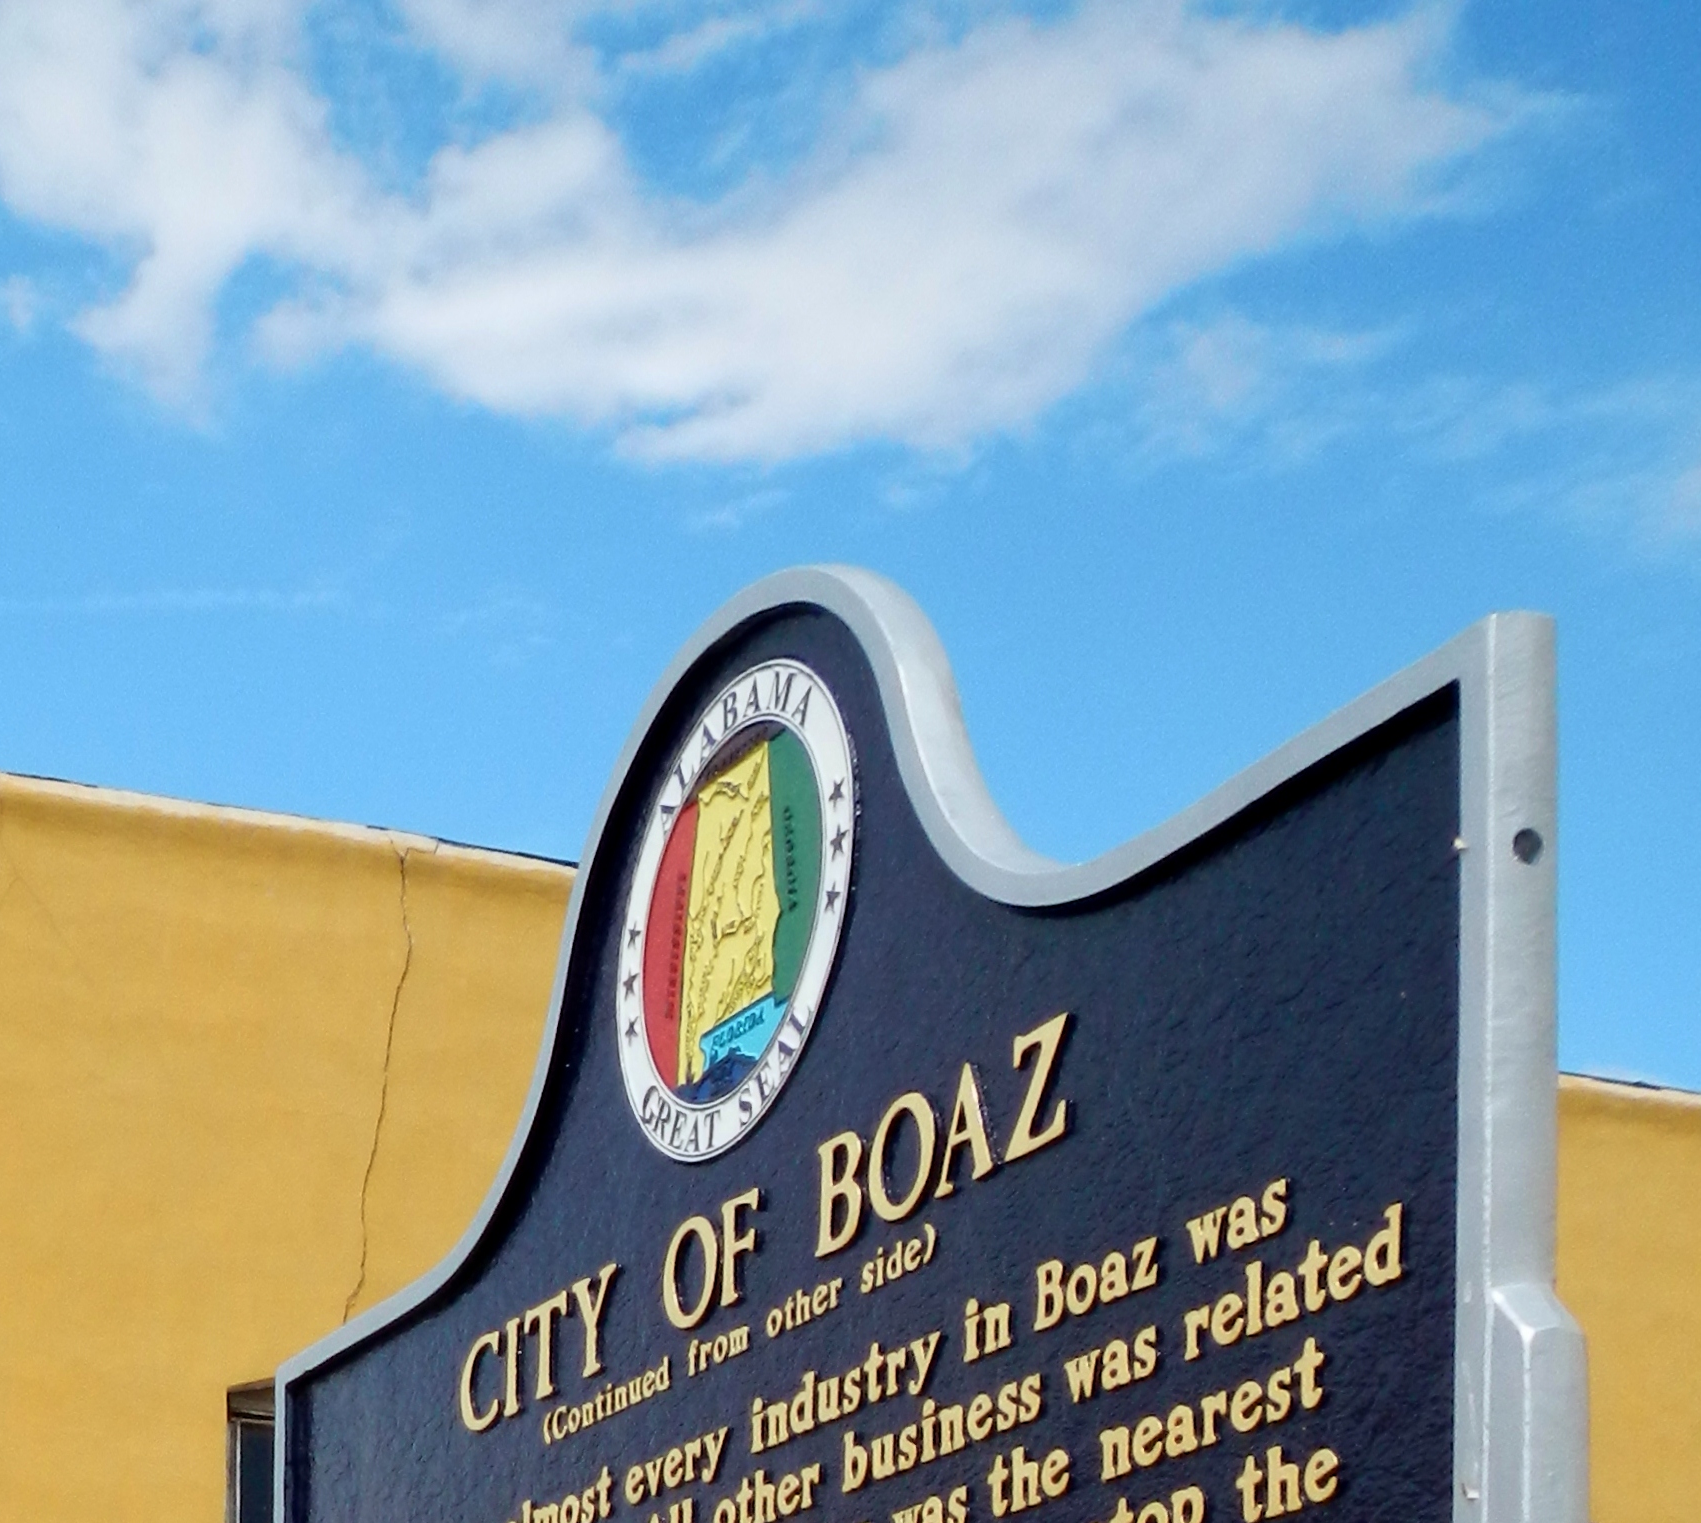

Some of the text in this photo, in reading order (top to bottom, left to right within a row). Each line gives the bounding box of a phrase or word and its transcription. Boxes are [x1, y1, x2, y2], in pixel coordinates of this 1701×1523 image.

[659, 669, 815, 840] ALABAMA
[639, 1004, 815, 1153] GREAT SEAL
[709, 1009, 766, 1050] FLORIDA
[462, 1014, 1067, 1431] CITY OF BOAZ
[542, 1223, 936, 1443] (Continued from other side)
[625, 1428, 728, 1504] every
[751, 1332, 941, 1454] industry
[964, 1298, 1011, 1363] in
[1036, 1236, 1158, 1331] Boaz
[1188, 1178, 1288, 1265] was
[842, 1373, 1042, 1494] business
[1065, 1325, 1158, 1403] was
[1184, 1202, 1403, 1362] related
[987, 1446, 1071, 1519] the
[1099, 1337, 1325, 1482] nearest
